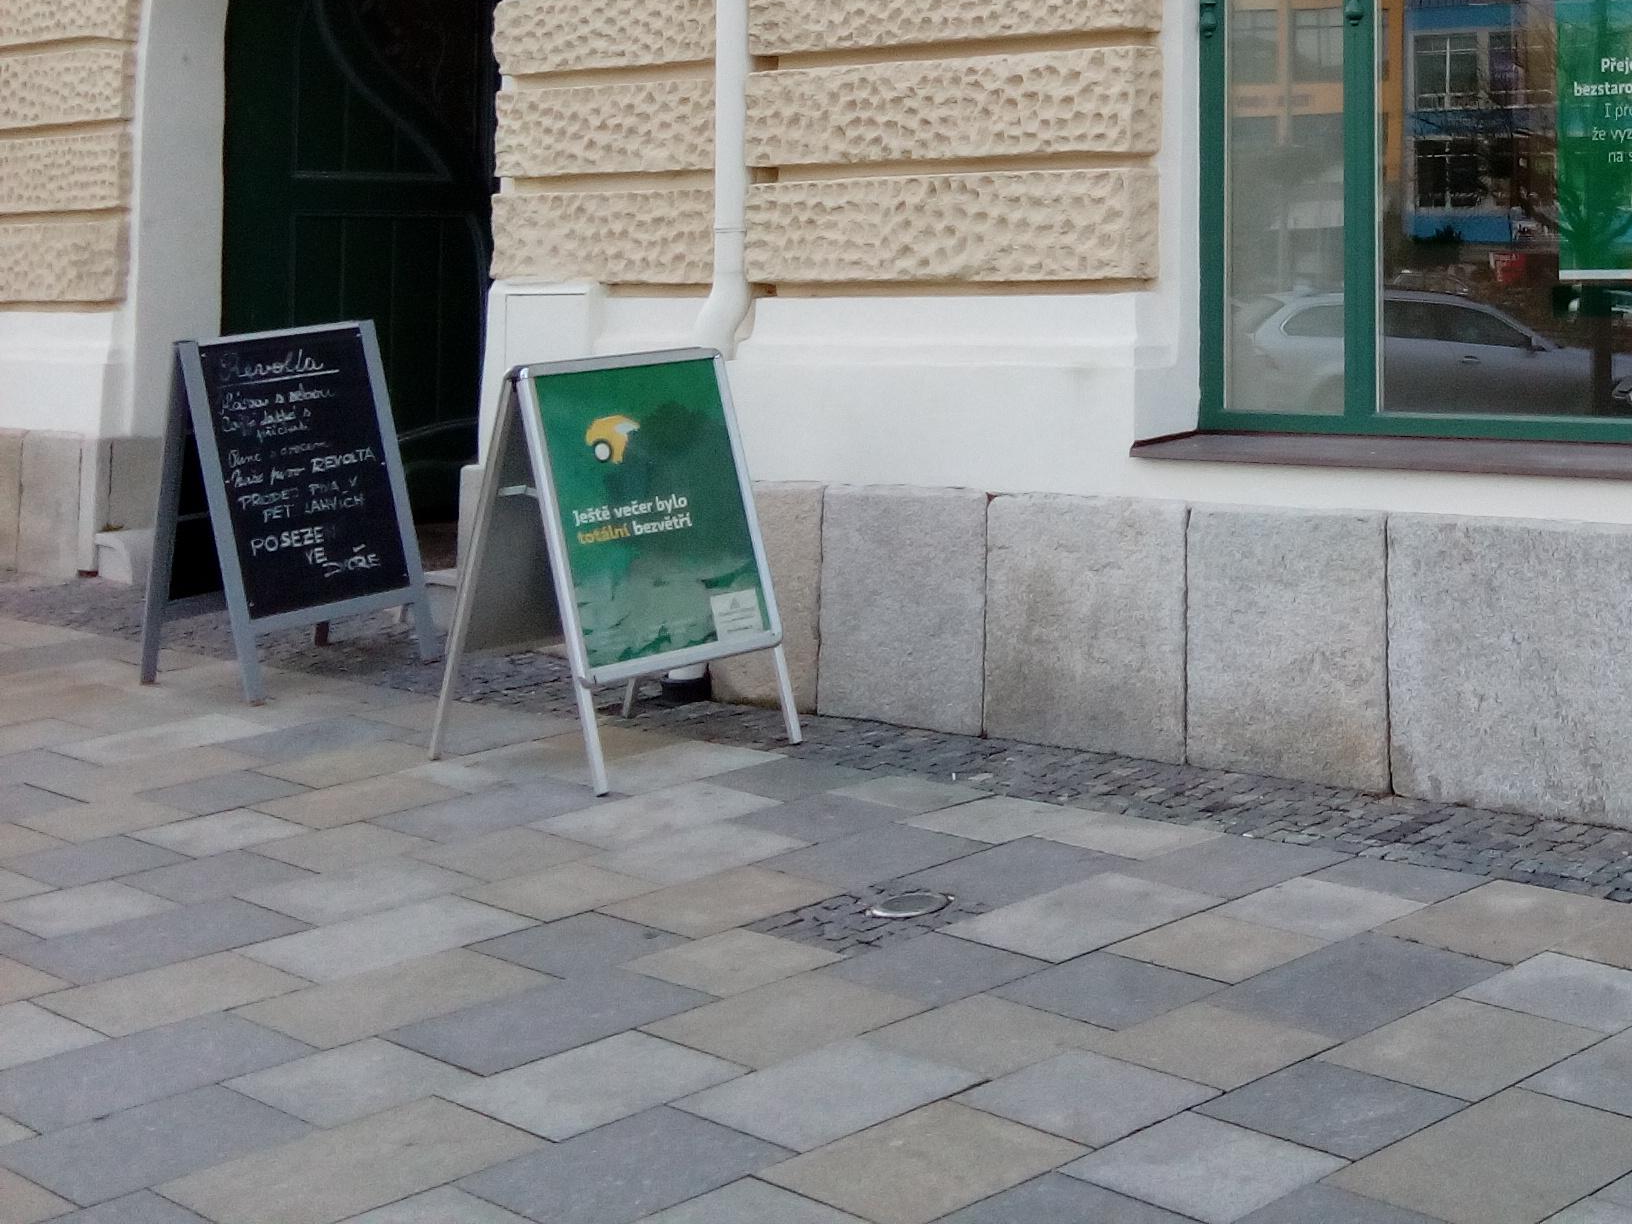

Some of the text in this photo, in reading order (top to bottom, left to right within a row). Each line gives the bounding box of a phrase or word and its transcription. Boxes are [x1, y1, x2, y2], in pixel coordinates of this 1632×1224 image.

[1604, 102, 1612, 118] I
[1591, 125, 1607, 141] že
[1608, 150, 1624, 163] na
[310, 445, 377, 474] REVOLTA
[572, 493, 688, 527] Ještě večer bylo
[577, 511, 693, 545] totální bezvětří
[305, 546, 328, 566] VE
